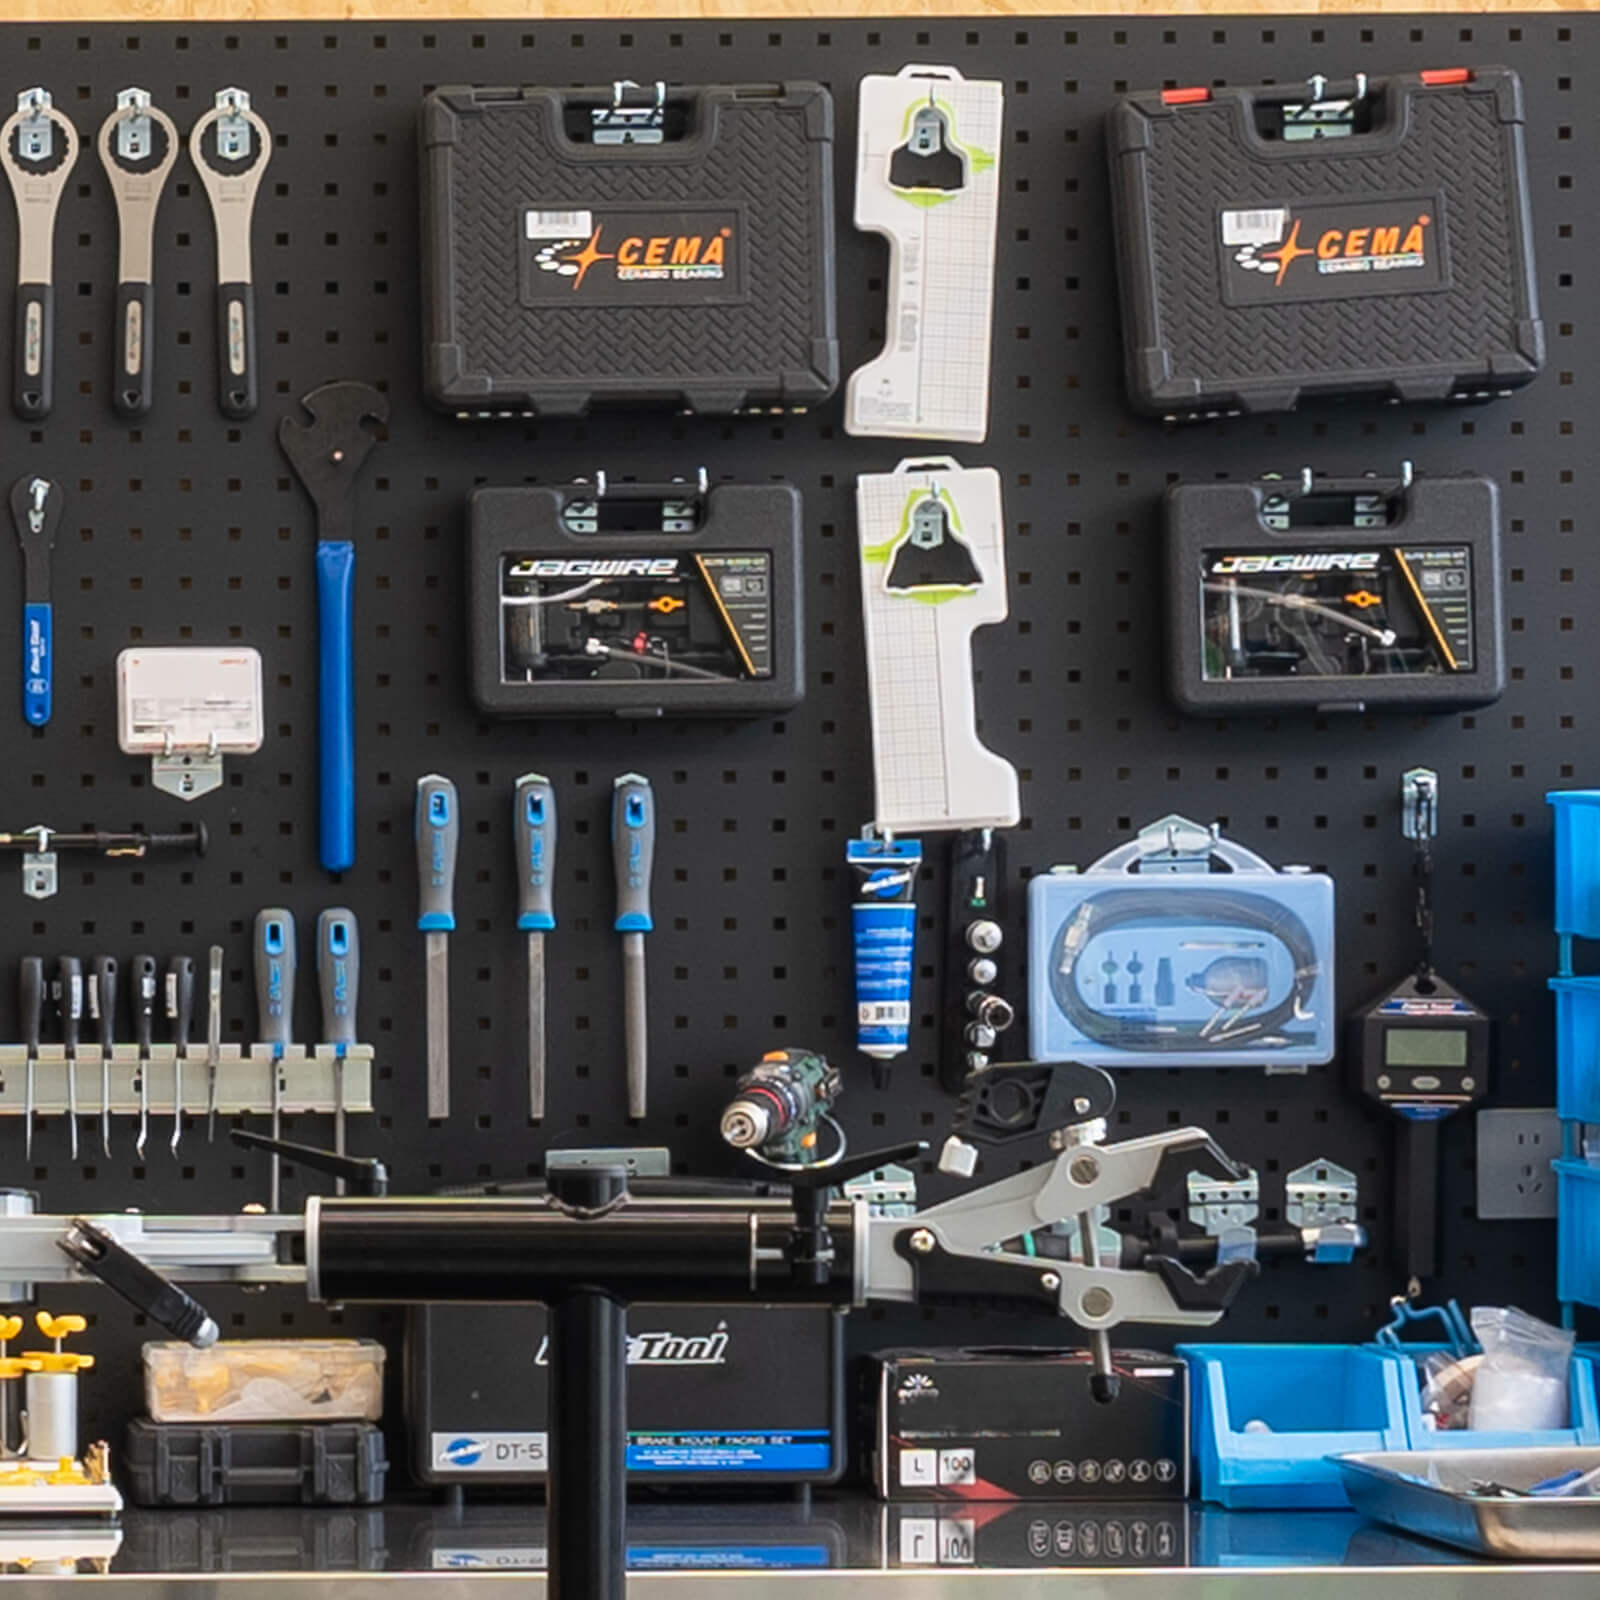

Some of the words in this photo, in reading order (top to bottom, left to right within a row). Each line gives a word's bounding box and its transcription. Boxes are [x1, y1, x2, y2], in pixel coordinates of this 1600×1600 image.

[617, 236, 725, 264] CEMA
[1317, 224, 1424, 259] CEMA
[943, 1456, 972, 1473] 100
